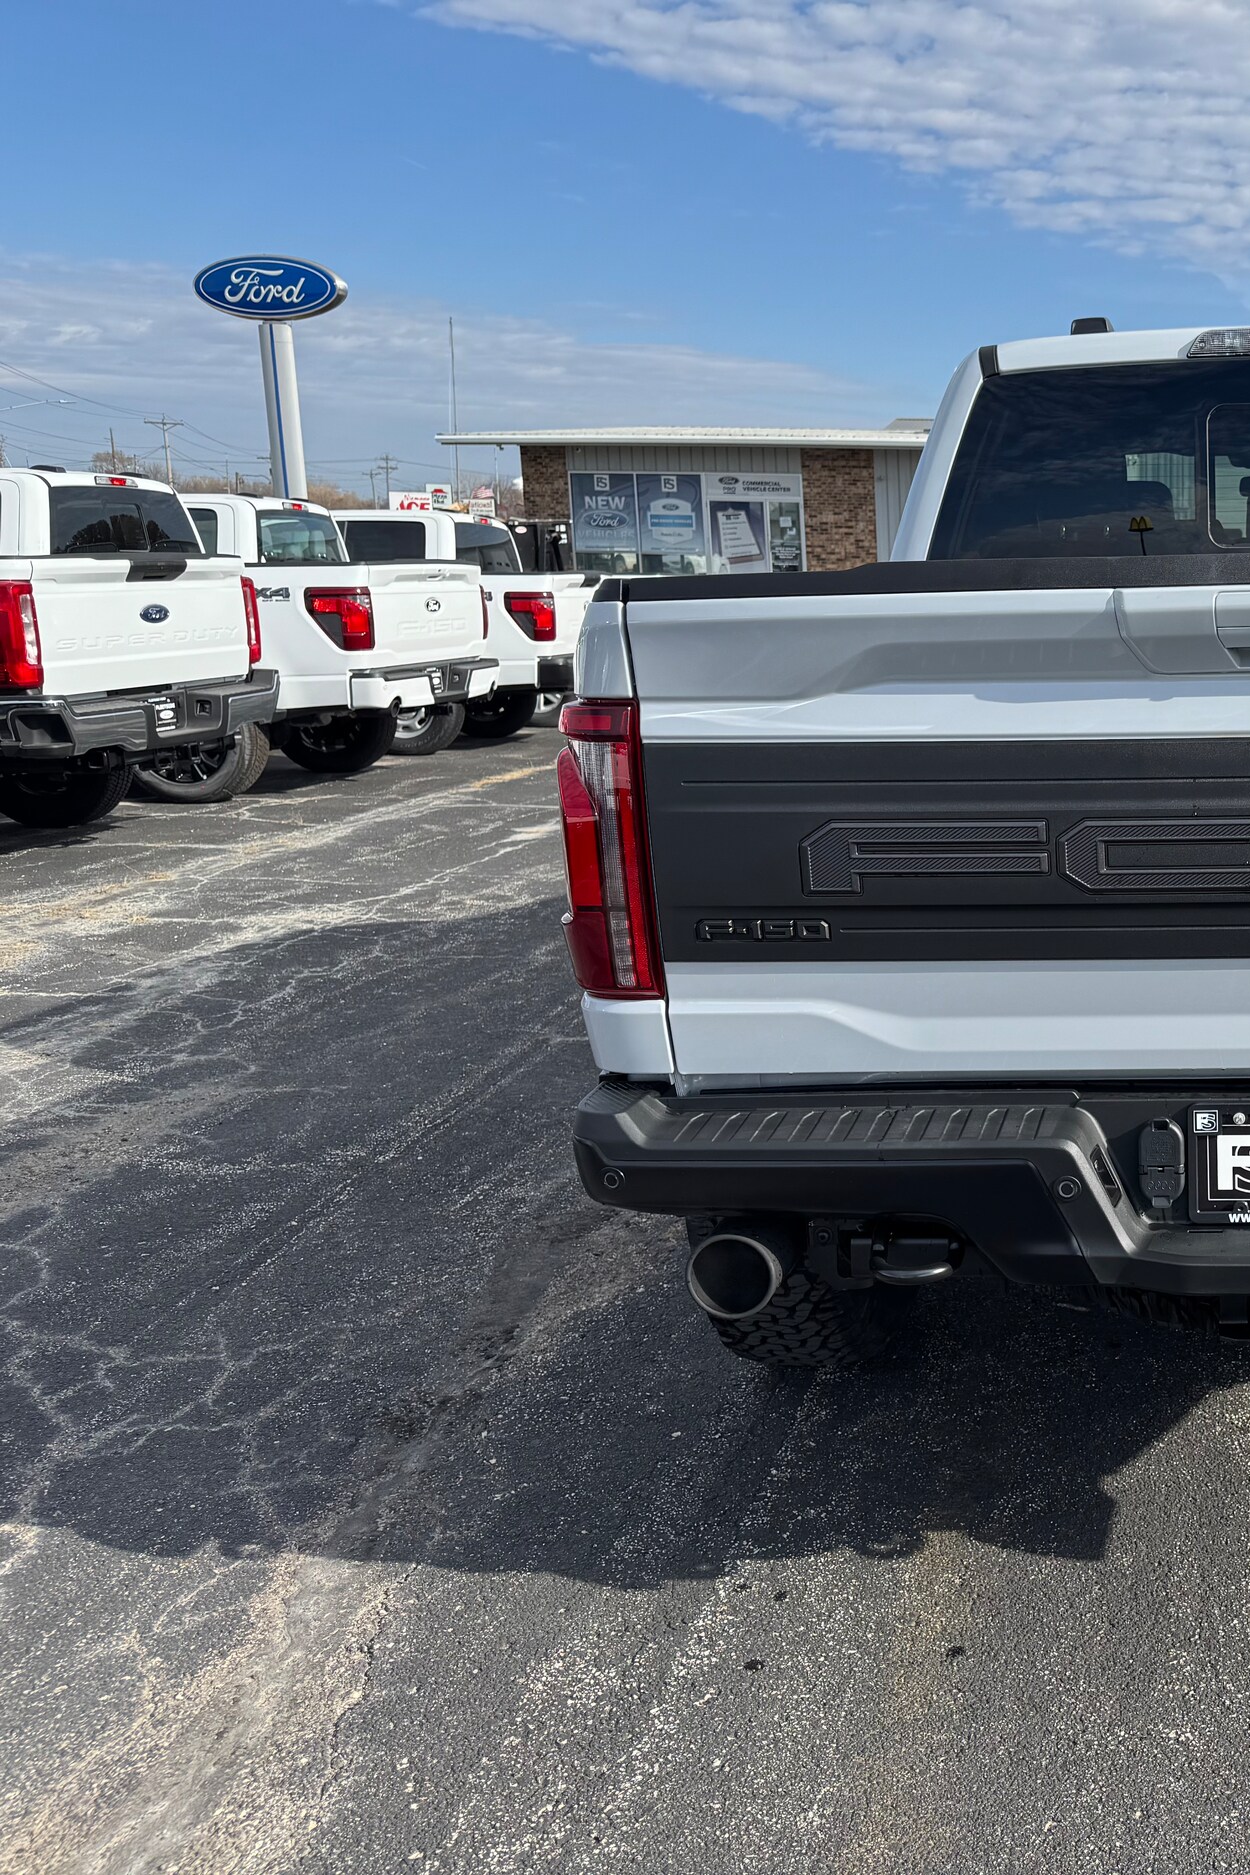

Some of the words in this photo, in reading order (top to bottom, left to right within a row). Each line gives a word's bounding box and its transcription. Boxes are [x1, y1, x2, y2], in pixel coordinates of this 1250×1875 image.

[224, 267, 305, 303] Ford
[584, 496, 626, 510] NEW
[590, 513, 620, 527] Ford
[253, 587, 291, 599] X4
[397, 618, 467, 638] F-150
[56, 631, 167, 652] SUPER
[171, 625, 239, 643] DUTY
[695, 918, 831, 943] F-150
[1196, 1113, 1217, 1131] FS
